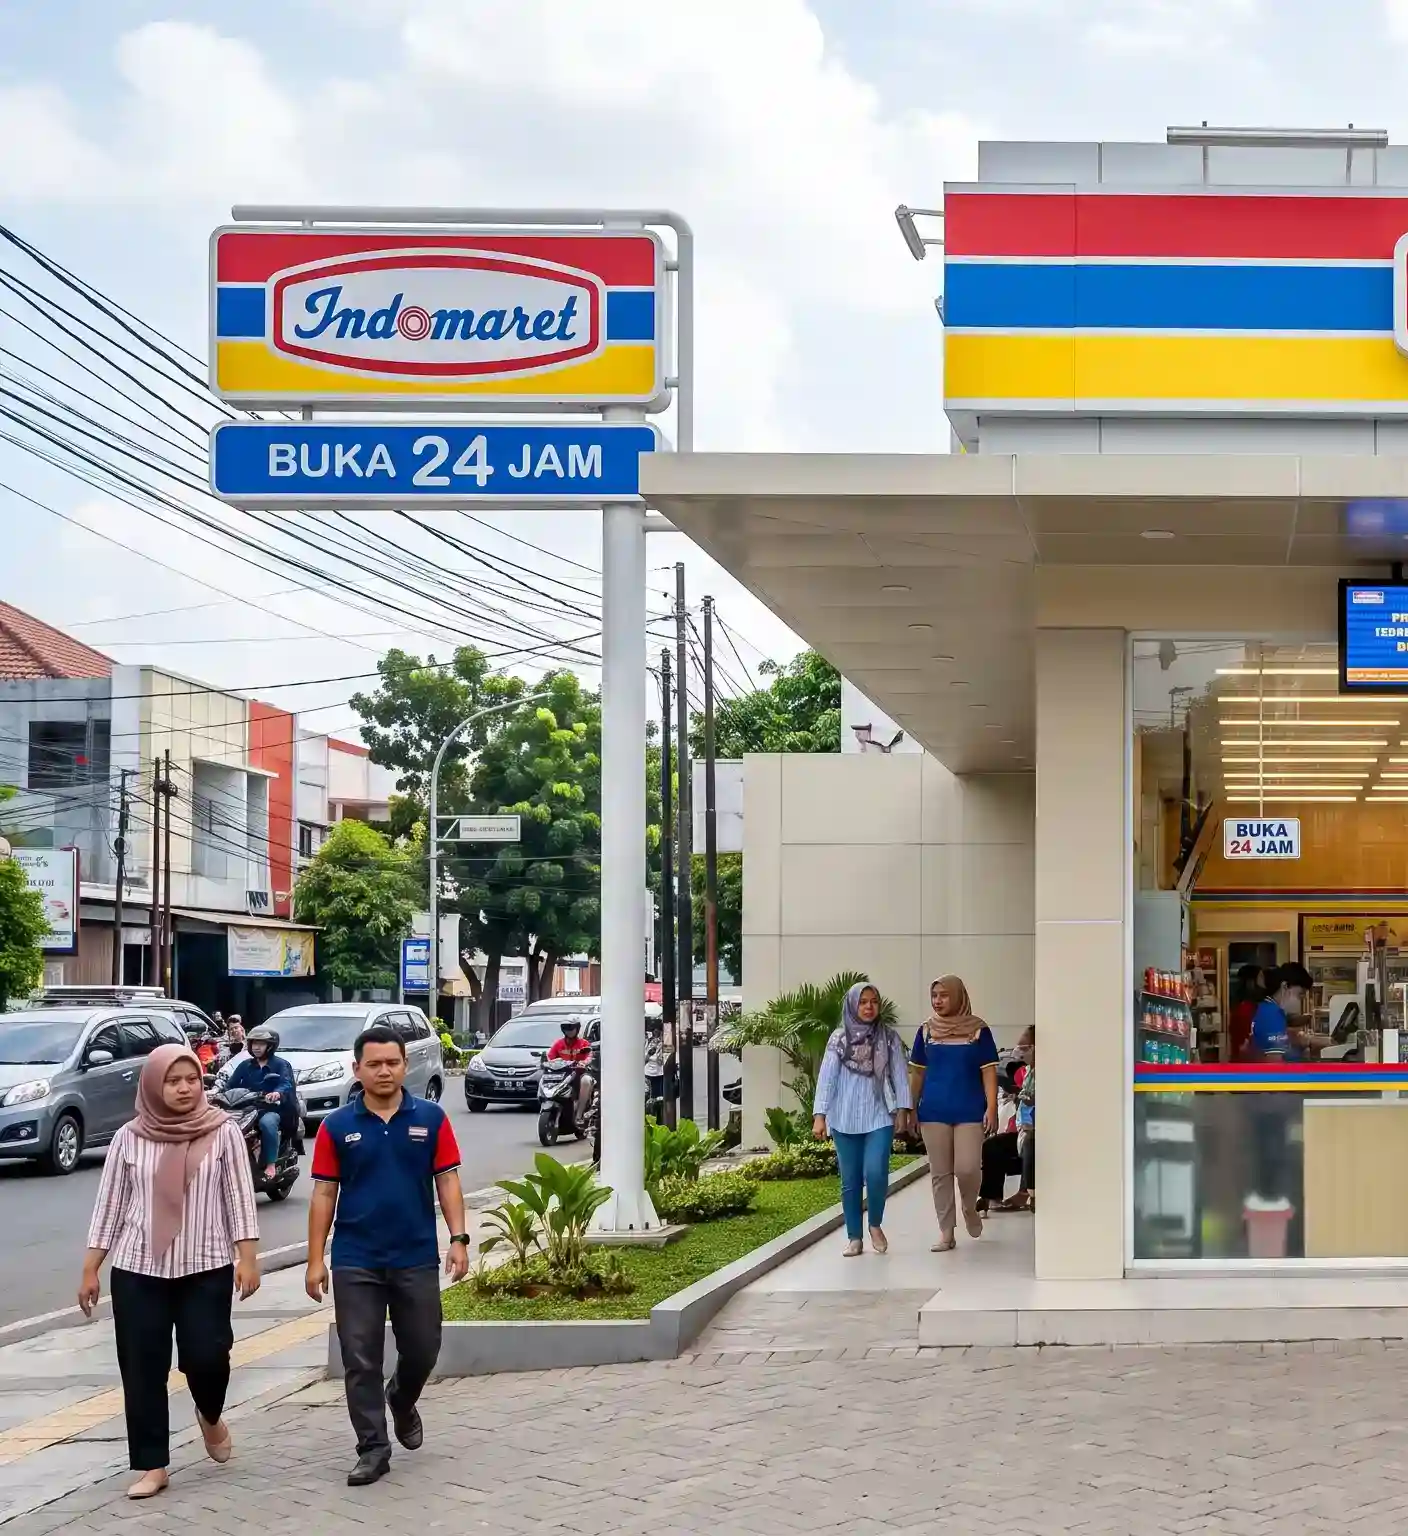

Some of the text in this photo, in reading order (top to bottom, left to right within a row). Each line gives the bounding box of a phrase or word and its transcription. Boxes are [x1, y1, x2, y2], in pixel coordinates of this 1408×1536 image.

[294, 285, 578, 341] Indomaret
[268, 435, 602, 487] BUKA 24 JAM
[1236, 823, 1288, 837] BUKA
[1230, 840, 1293, 854] 24 JAM
